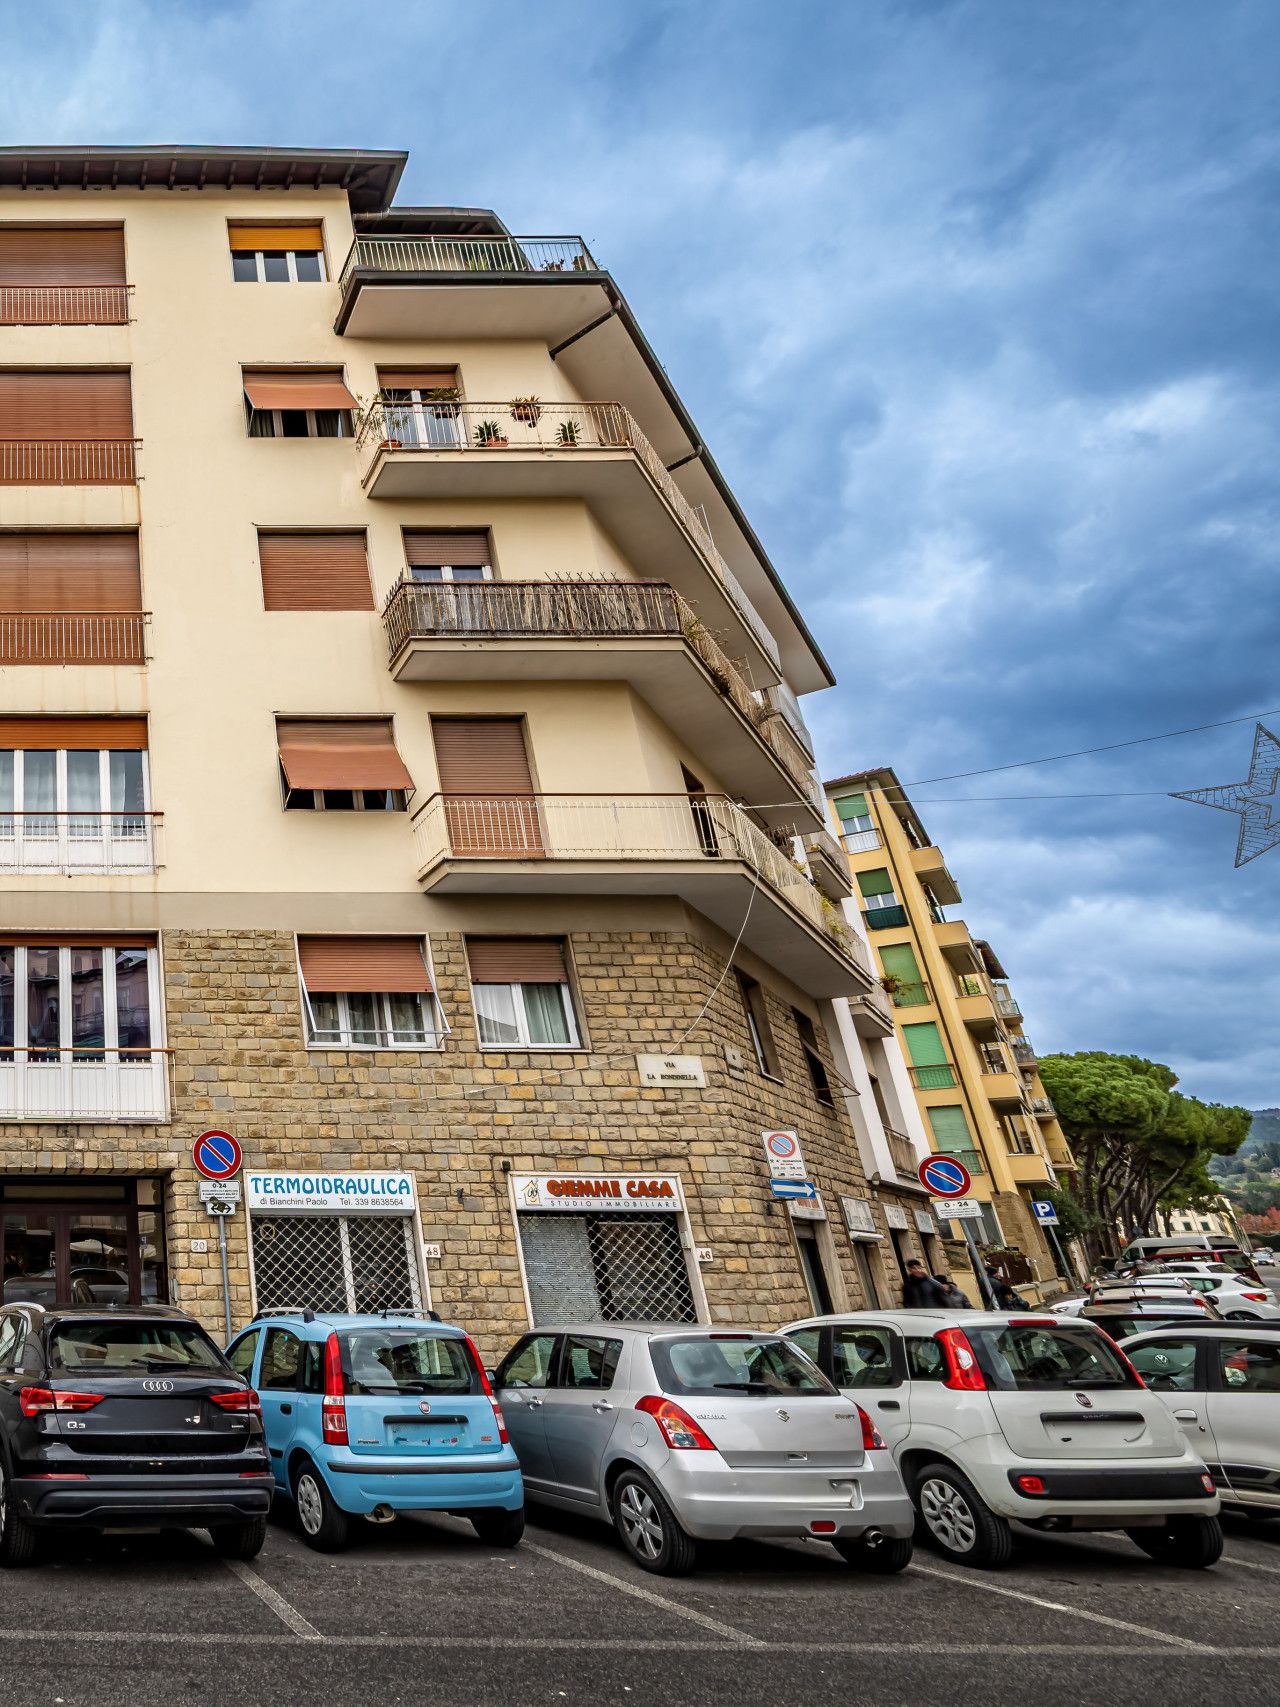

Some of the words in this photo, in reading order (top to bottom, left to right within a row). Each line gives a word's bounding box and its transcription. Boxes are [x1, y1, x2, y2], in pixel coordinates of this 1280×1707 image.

[250, 1177, 411, 1195] TERMOIDRAULICA
[626, 1180, 675, 1198] CASA
[269, 1198, 304, 1206] Bianchini
[306, 1198, 328, 1206] Paolo
[339, 1198, 352, 1206] Tel.
[355, 1198, 369, 1206] 339
[371, 1198, 404, 1206] 8638564
[1036, 1203, 1050, 1217] P
[192, 1241, 205, 1251] 20
[426, 1247, 439, 1256] 48
[699, 1250, 711, 1260] 46
[67, 1421, 86, 1429] Q3
